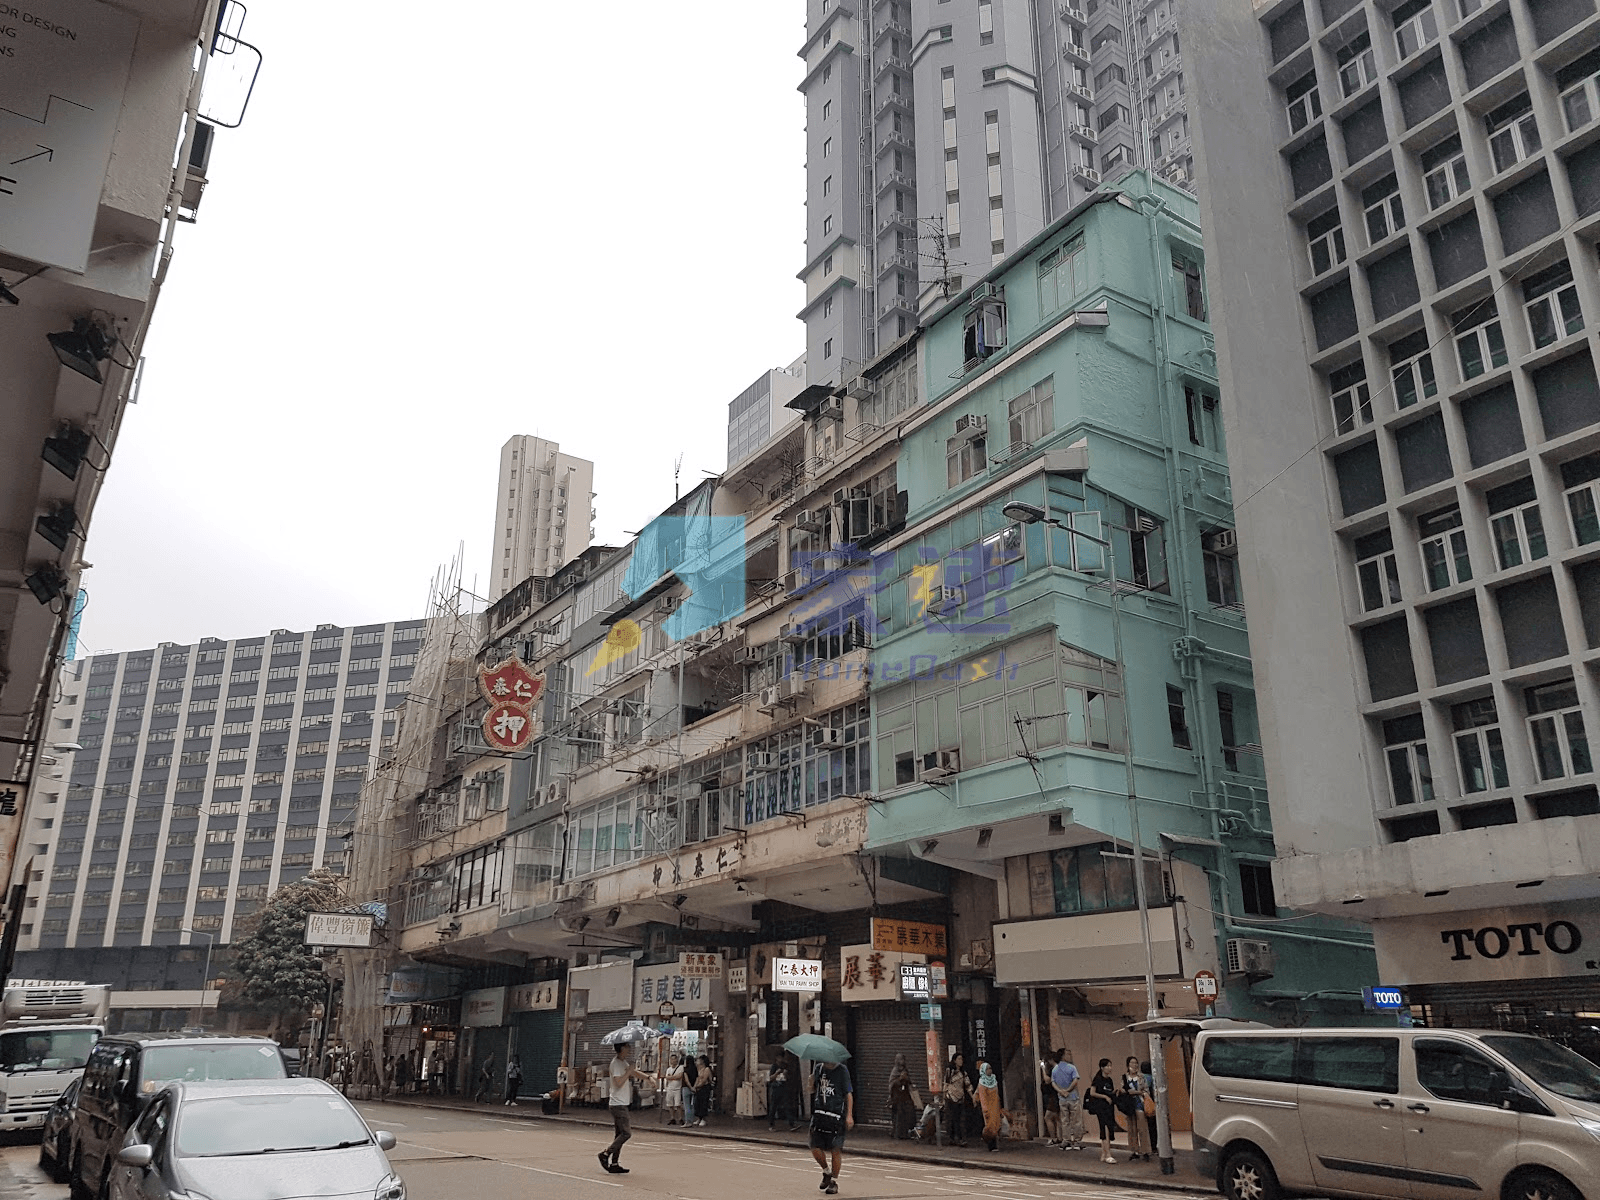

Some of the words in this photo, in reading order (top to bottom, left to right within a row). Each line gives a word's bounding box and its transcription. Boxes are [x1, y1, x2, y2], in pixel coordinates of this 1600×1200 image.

[23, 13, 77, 41] DESIGN
[492, 709, 527, 744] 押
[1440, 920, 1582, 961] TOTO
[685, 954, 717, 966] 新萬象
[779, 963, 819, 977] 仁泰大押
[1373, 992, 1402, 1004] TOTO
[975, 1019, 988, 1057] 室內設計
